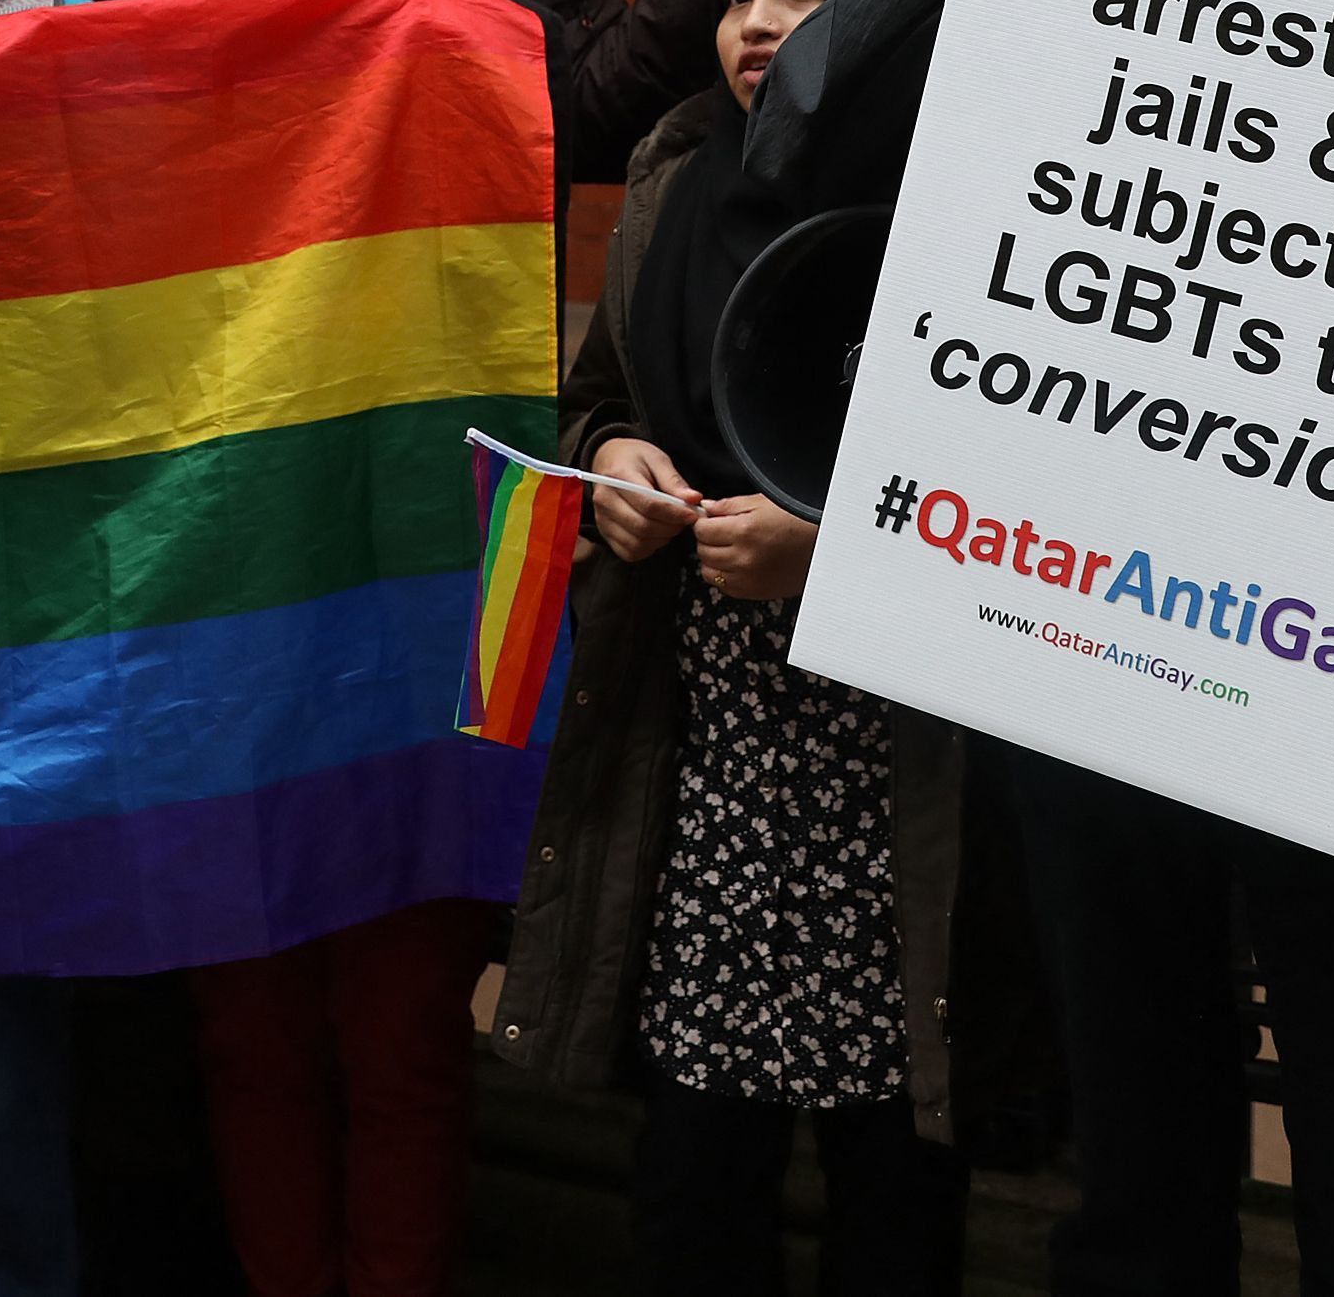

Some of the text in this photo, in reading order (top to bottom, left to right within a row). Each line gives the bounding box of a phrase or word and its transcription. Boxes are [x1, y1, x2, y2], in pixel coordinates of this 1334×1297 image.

[1087, 57, 1278, 163] jails
[987, 232, 1284, 374] LGBTs
[979, 605, 1248, 706] www.QatarAntiGay.com
